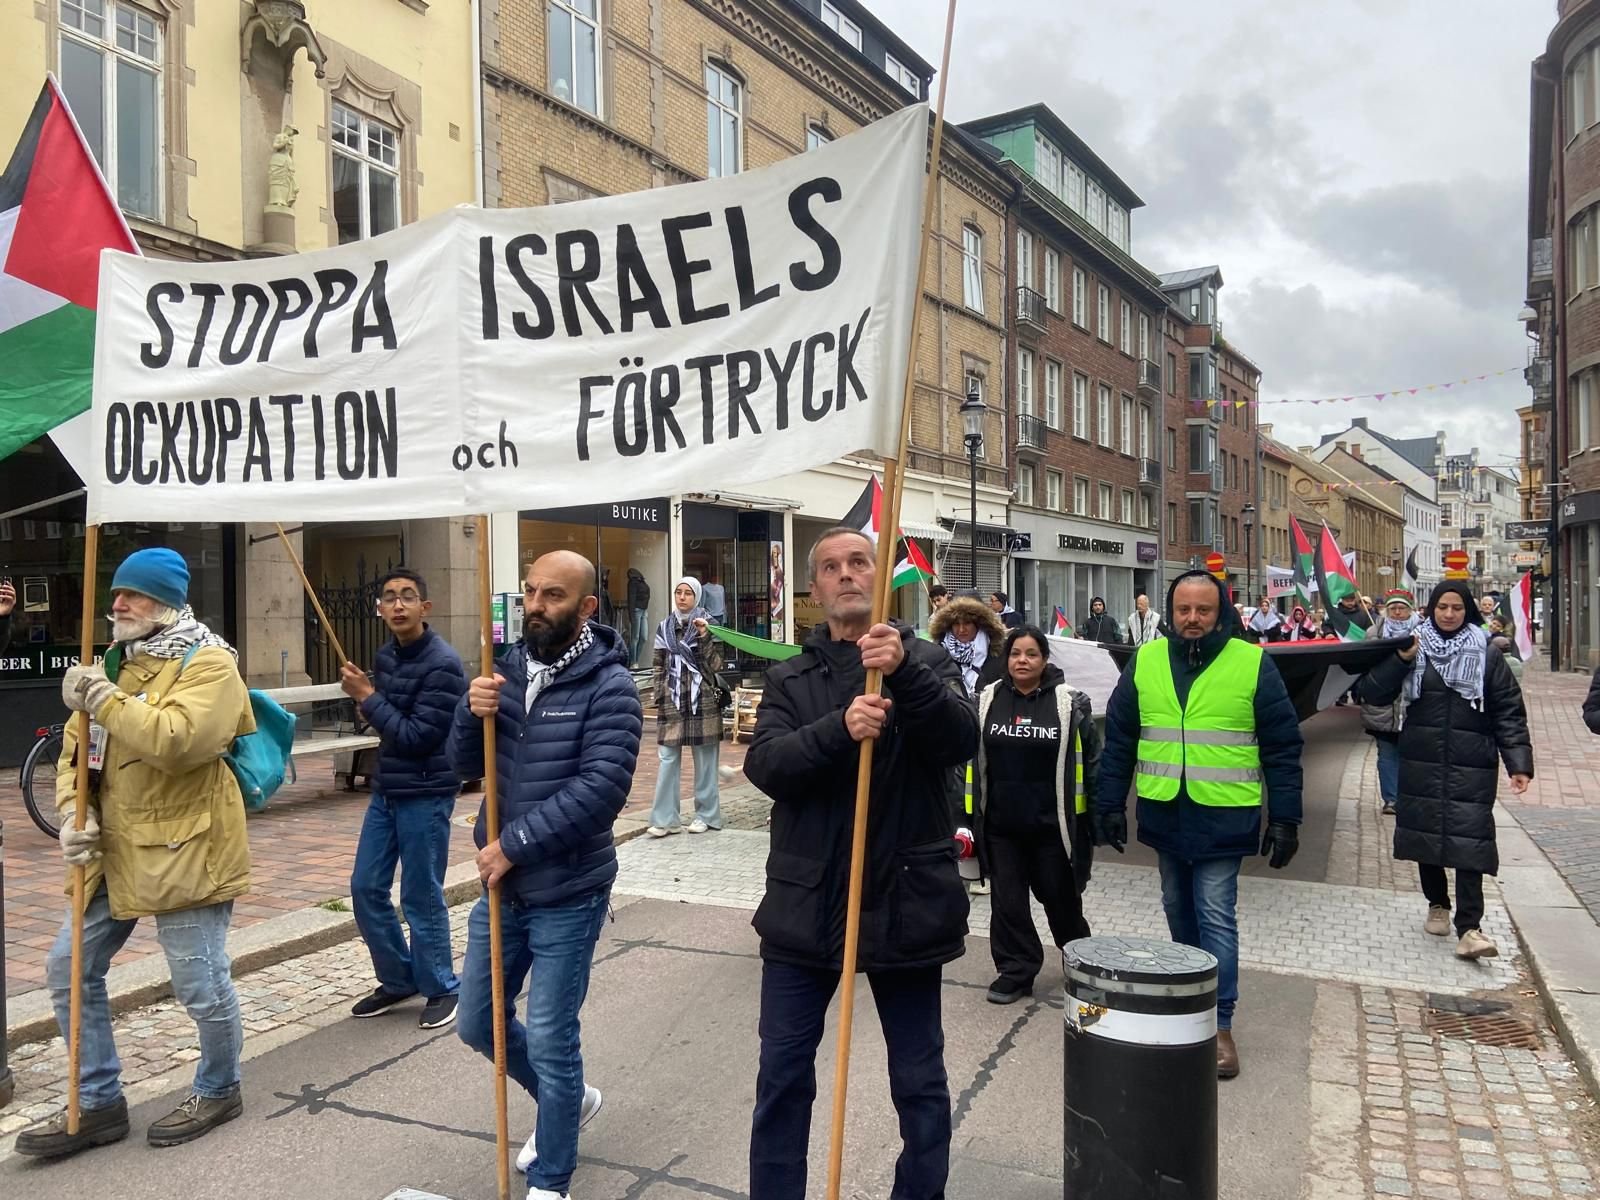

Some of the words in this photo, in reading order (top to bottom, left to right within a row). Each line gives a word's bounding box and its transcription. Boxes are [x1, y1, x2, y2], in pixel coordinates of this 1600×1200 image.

[140, 260, 397, 369] STOPPA
[479, 176, 842, 340] ISRAELS
[104, 387, 398, 485] OCKUPATION
[452, 420, 518, 471] och
[577, 306, 871, 461] FÖRTRYCK
[612, 504, 658, 522] BUTIKE
[990, 723, 1058, 740] PALESTINE
